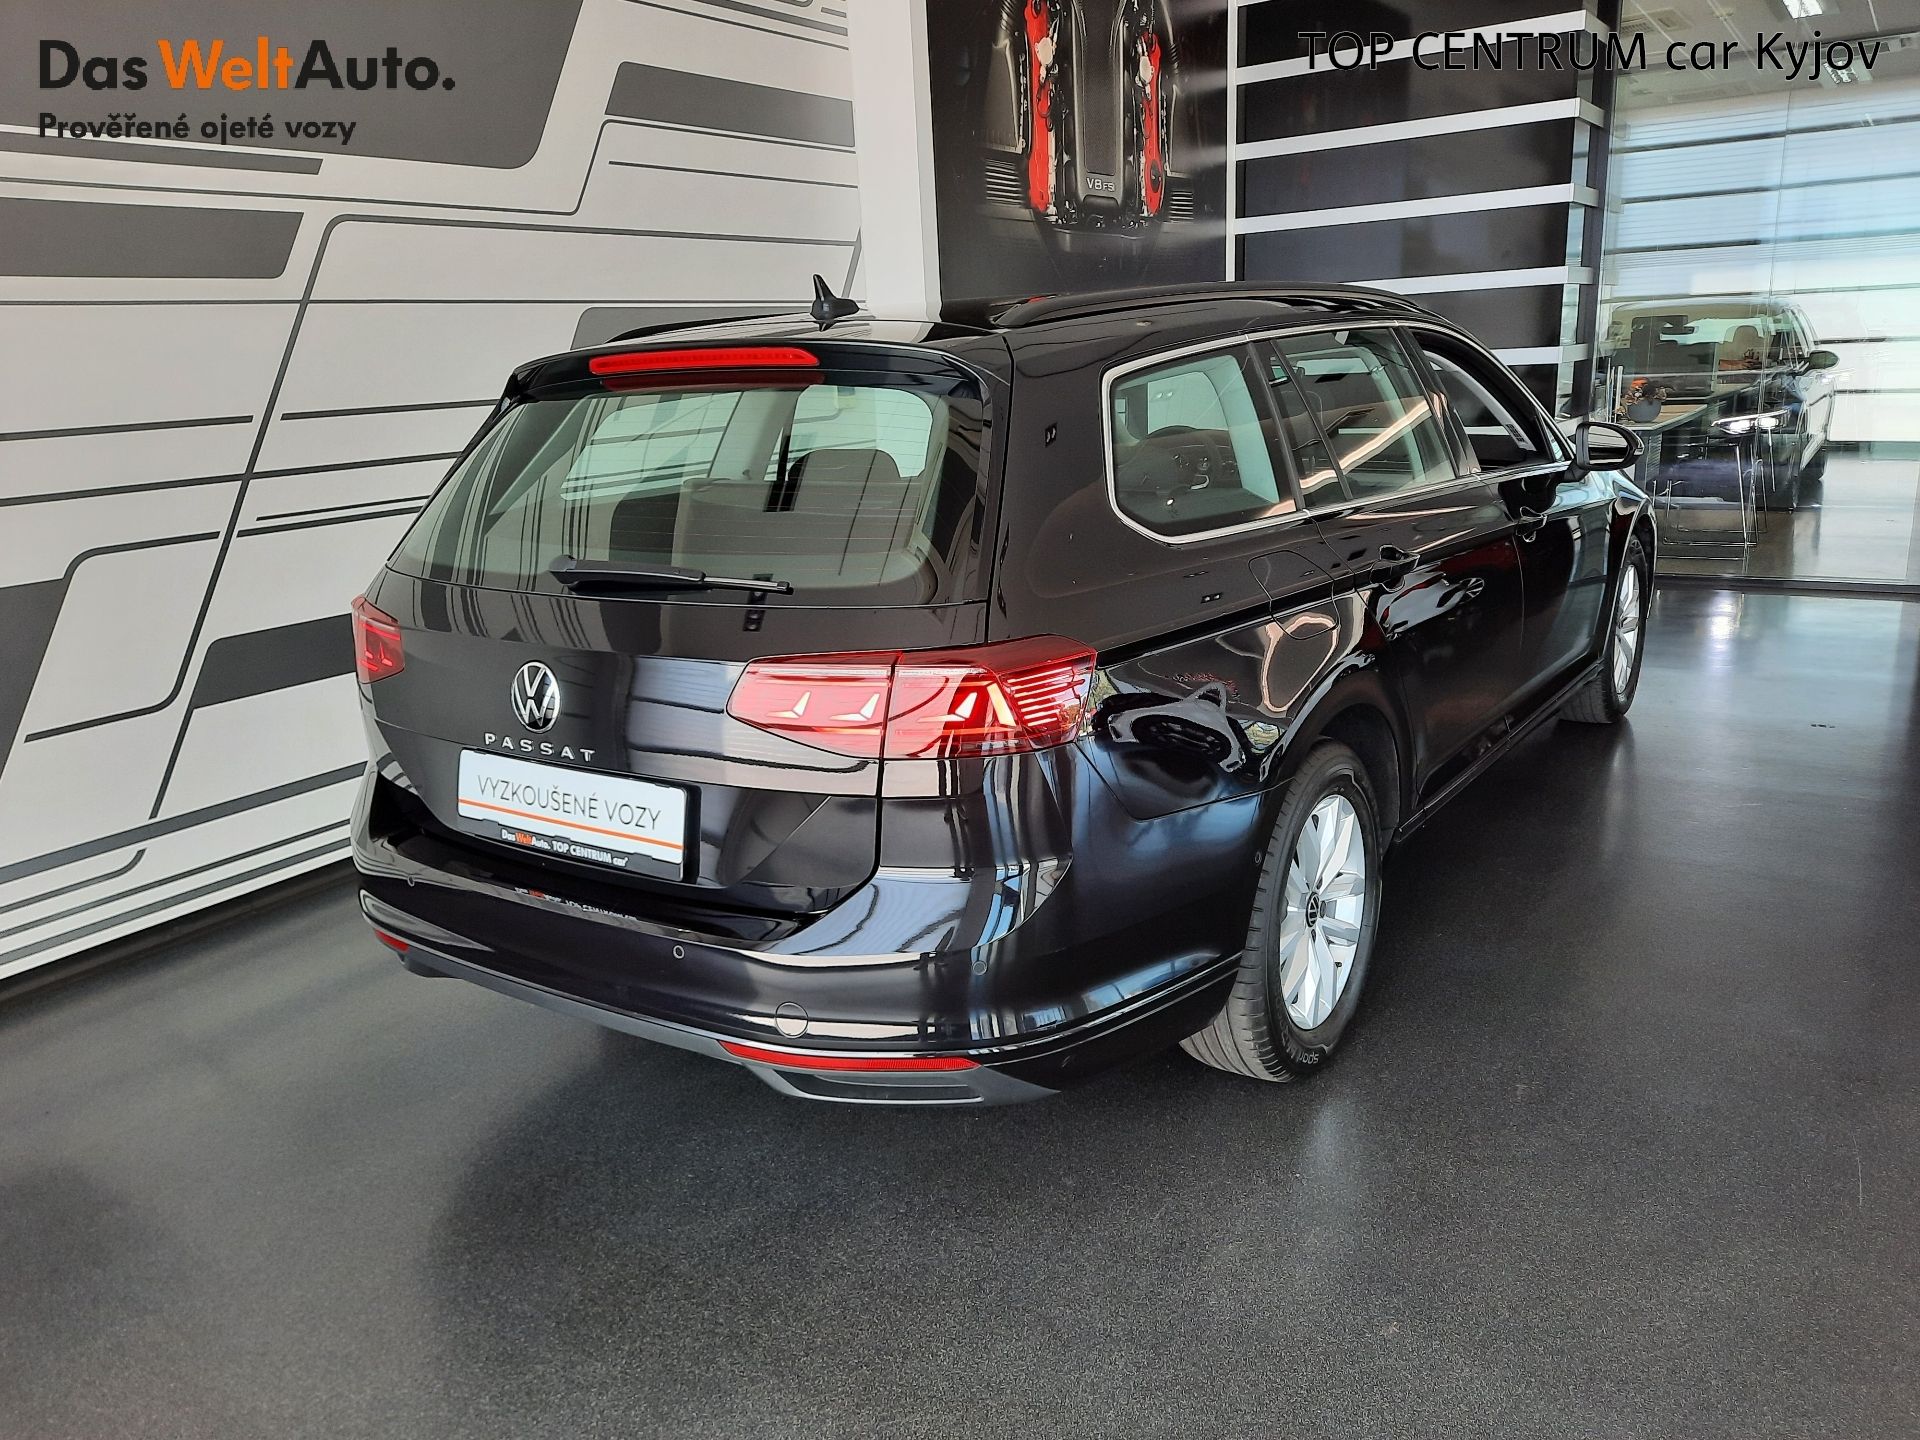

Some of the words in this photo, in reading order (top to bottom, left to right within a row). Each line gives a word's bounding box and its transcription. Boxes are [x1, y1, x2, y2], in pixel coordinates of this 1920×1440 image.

[484, 733, 595, 762] PASSAT
[478, 775, 598, 819] VYZKOUŠENÉ
[604, 799, 661, 830] VOZY
[552, 840, 570, 854] TOP
[570, 846, 612, 864] CENTRUM
